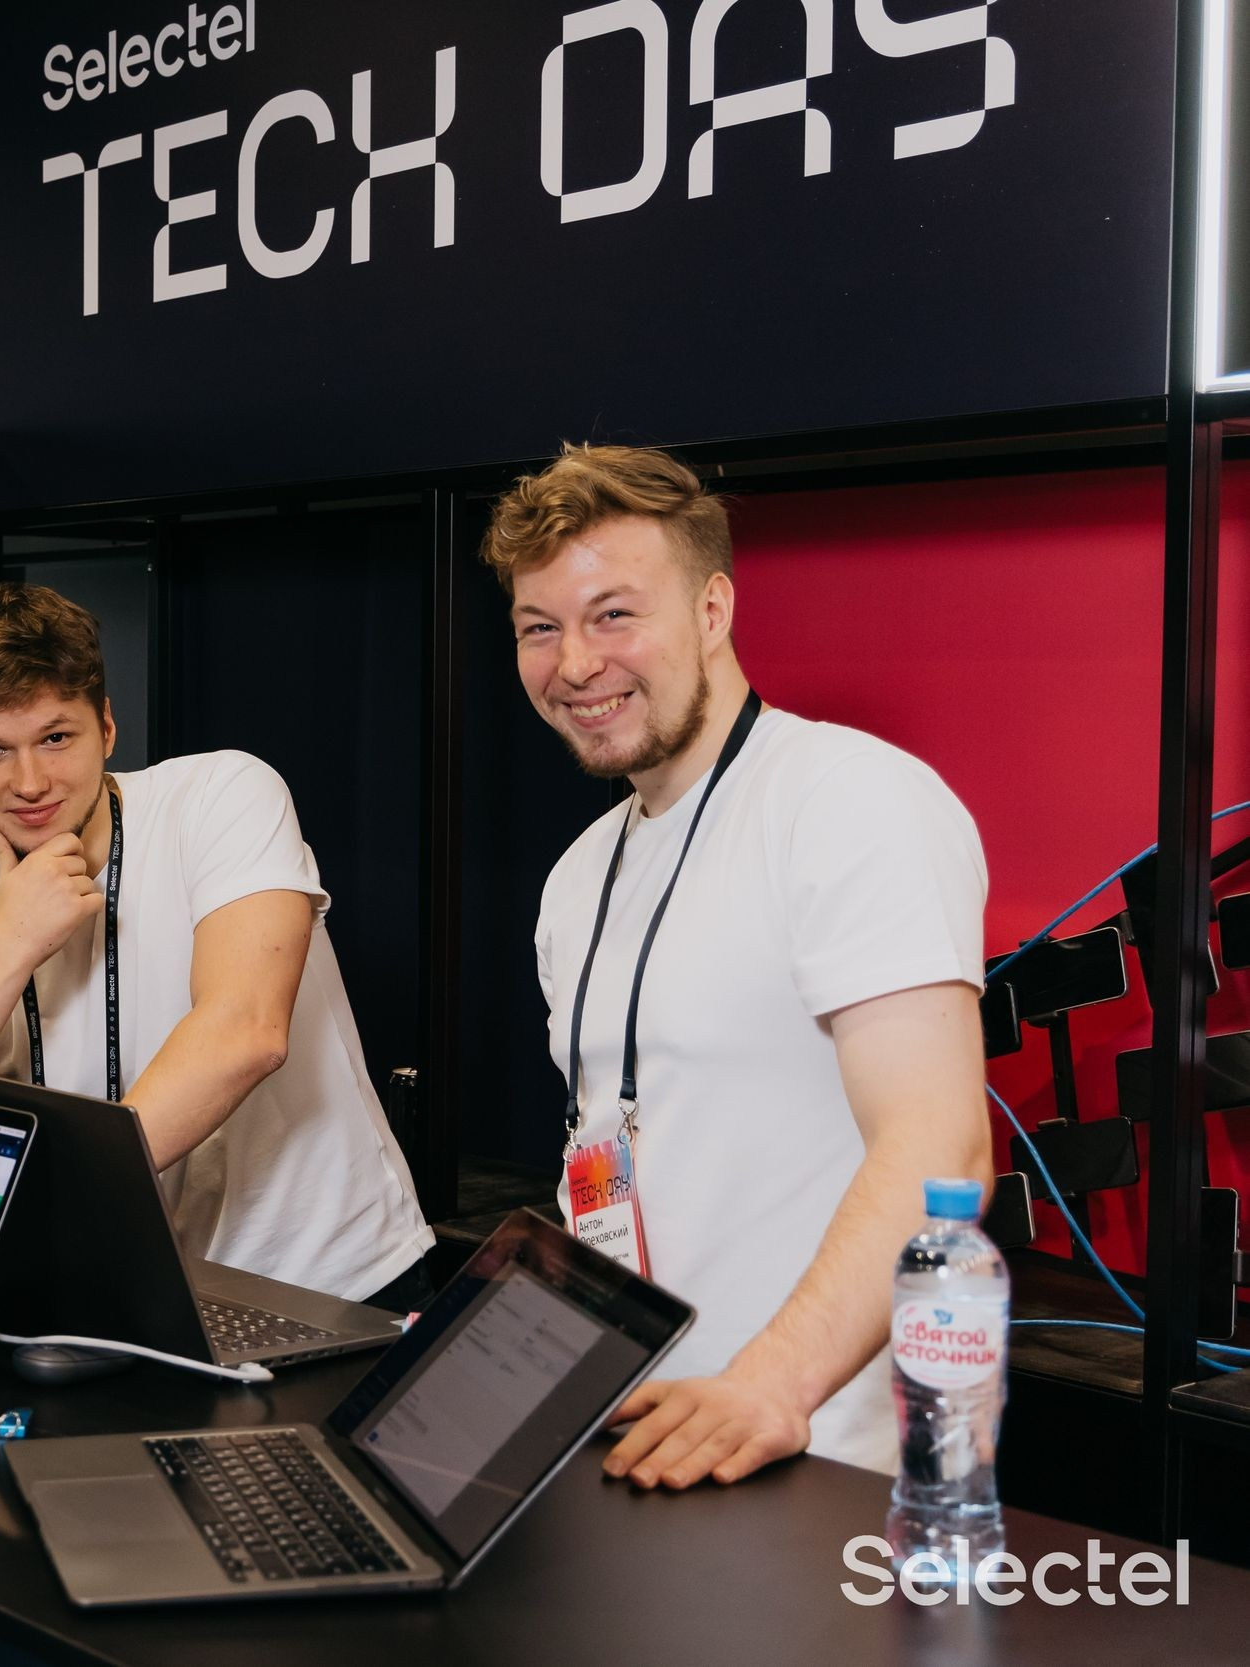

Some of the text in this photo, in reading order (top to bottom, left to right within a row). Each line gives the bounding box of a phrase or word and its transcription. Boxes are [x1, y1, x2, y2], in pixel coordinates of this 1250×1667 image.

[42, 0, 256, 111] Selectel
[42, 0, 1016, 317] TECH DAY
[109, 864, 118, 891] Selectel
[572, 1173, 630, 1206] TECH DAY
[579, 1217, 603, 1234] Антон
